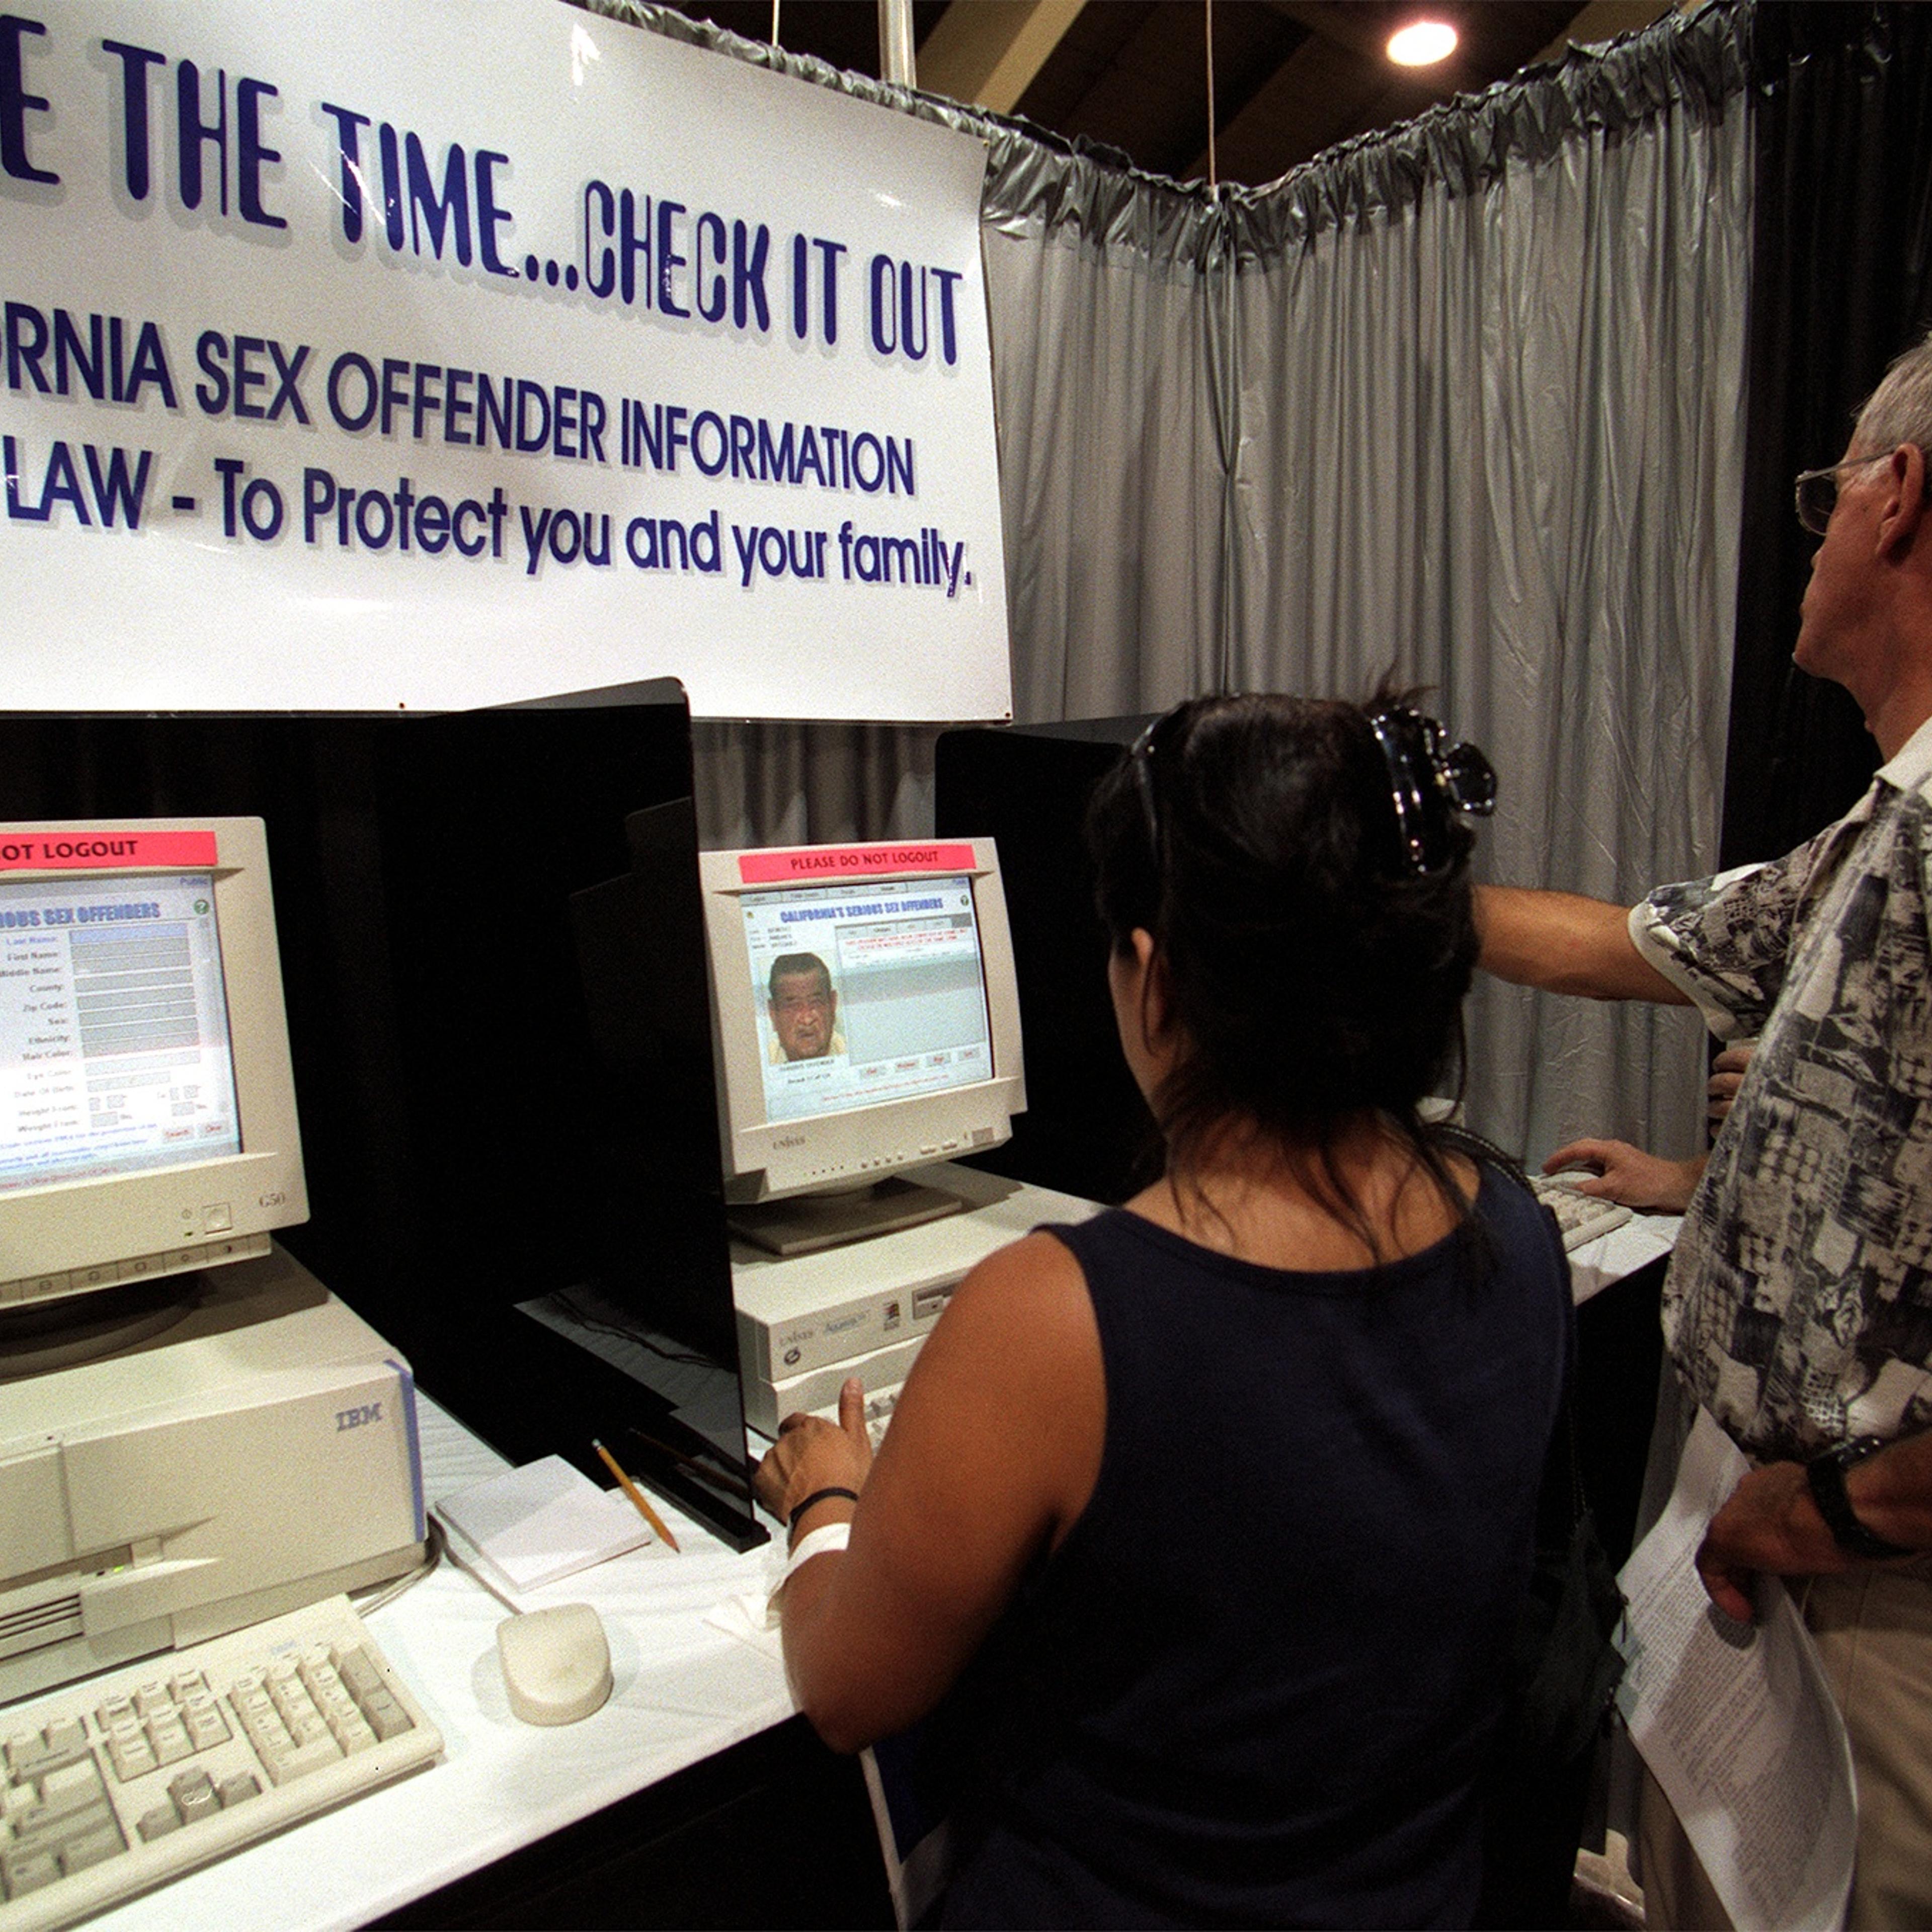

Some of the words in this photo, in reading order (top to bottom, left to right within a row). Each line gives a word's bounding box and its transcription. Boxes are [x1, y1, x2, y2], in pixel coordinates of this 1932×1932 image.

[102, 39, 287, 229] THE
[793, 233, 847, 345] IT
[871, 254, 962, 365] OUT
[0, 301, 178, 409] RNIA
[196, 331, 310, 425] SEX
[327, 353, 606, 462] OFFENDER
[621, 397, 914, 496] INFORMATION
[3, 435, 152, 530] LAW
[214, 457, 283, 541] To
[304, 468, 508, 557] Protect
[519, 505, 611, 575] you
[625, 509, 721, 572] and
[732, 525, 828, 587] your
[838, 521, 972, 598] family.
[43, 841, 138, 859] LOGOUT
[790, 856, 835, 870] PLEASE
[840, 855, 858, 866] DO
[863, 853, 888, 865] NOT
[893, 851, 938, 864] LOGOUT
[43, 907, 74, 925] SEX
[77, 902, 160, 923] OFFENDERS
[780, 907, 845, 923] CALIFORNIA'S
[846, 903, 883, 917] SERIOUS
[884, 901, 900, 914] SEX
[901, 898, 944, 912] OFFENDERS
[336, 1402, 382, 1432] IBM
